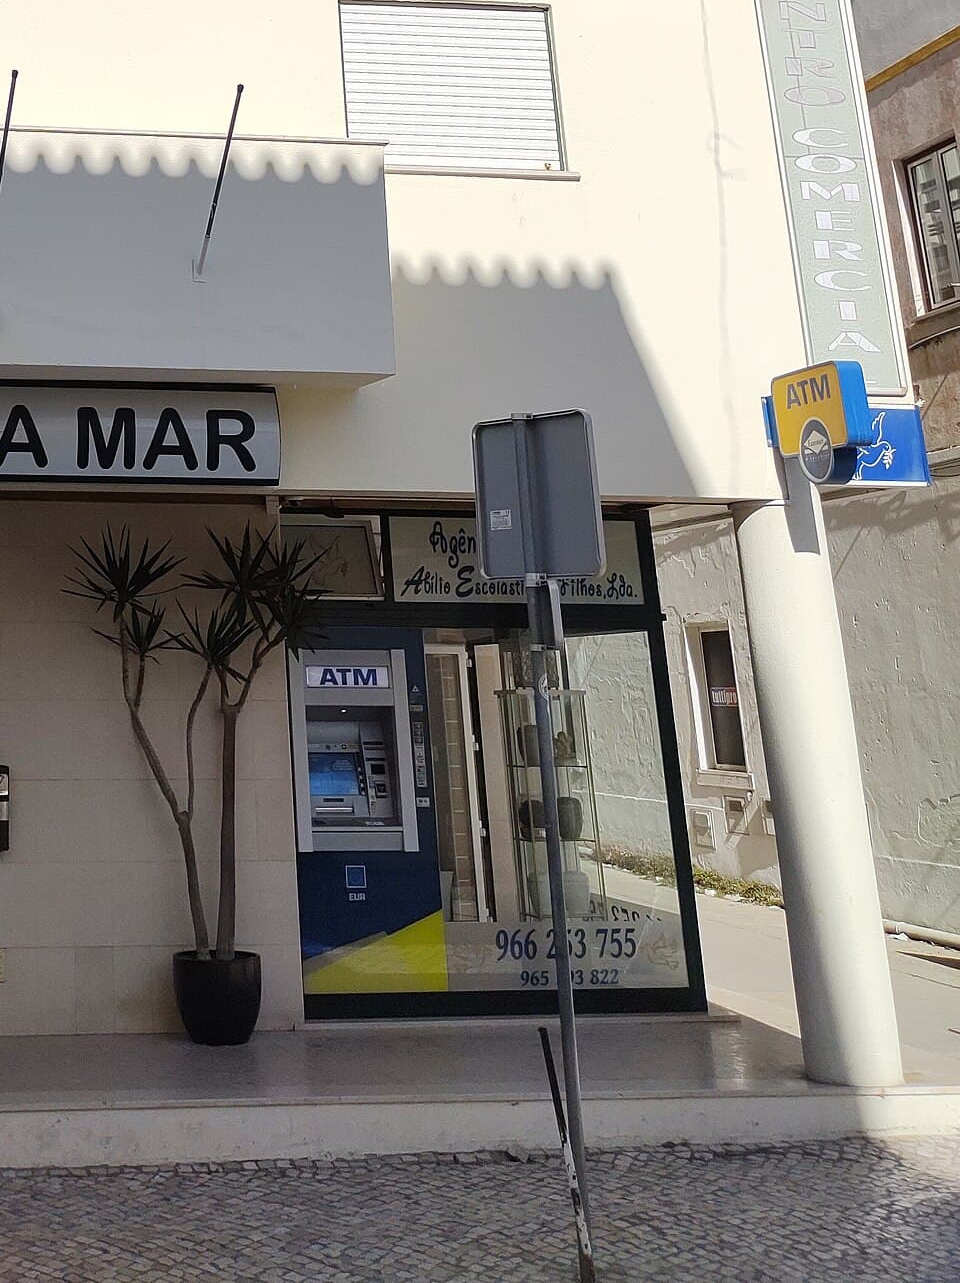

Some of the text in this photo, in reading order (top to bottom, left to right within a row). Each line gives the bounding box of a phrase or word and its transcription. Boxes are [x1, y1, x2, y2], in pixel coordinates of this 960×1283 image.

[792, 127, 880, 384] COMERCIA
[786, 373, 831, 409] ATM
[76, 406, 257, 473] MAR
[429, 520, 477, 569] Agên
[401, 566, 452, 598] Abílio
[320, 668, 378, 686] ATM
[348, 892, 366, 901] EUR
[496, 928, 538, 961] 966
[595, 927, 637, 959] 755
[520, 970, 549, 987] 965
[590, 969, 620, 985] 822
